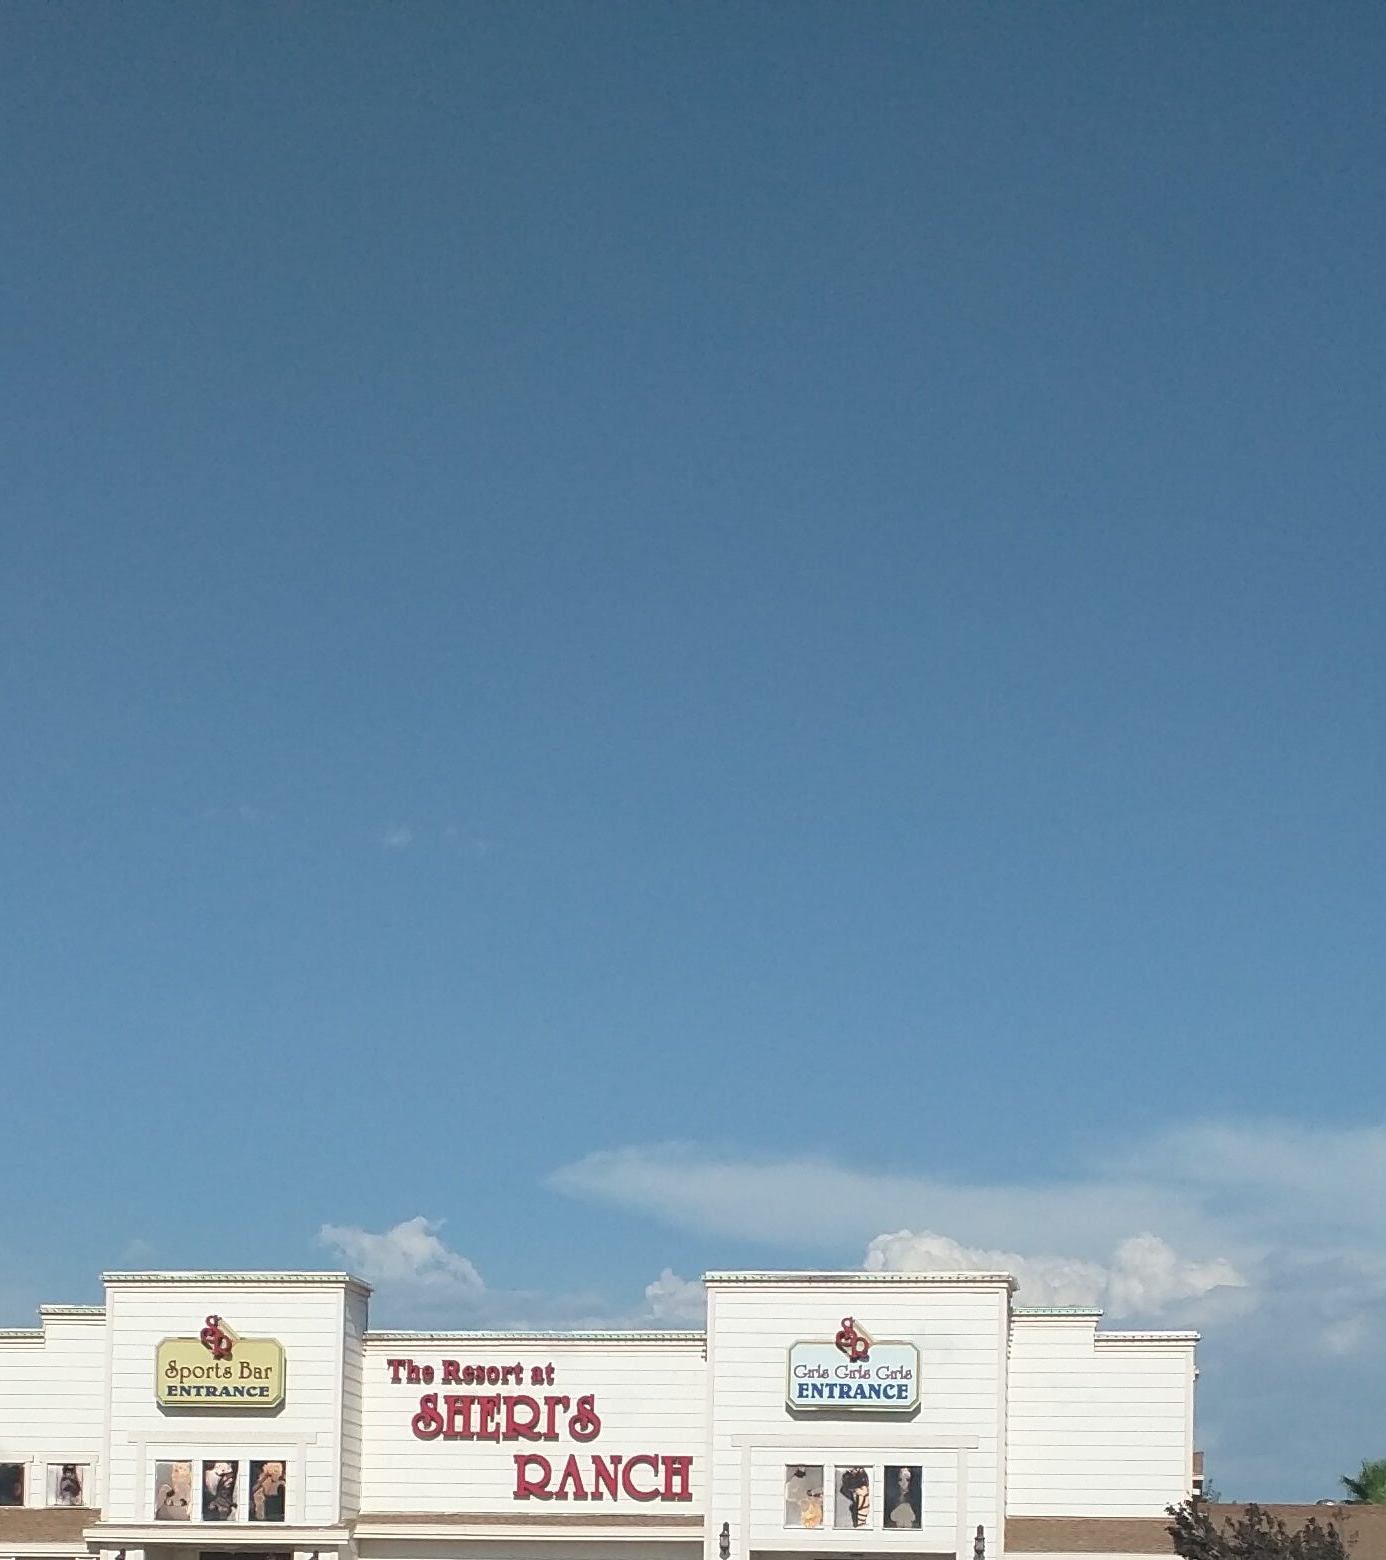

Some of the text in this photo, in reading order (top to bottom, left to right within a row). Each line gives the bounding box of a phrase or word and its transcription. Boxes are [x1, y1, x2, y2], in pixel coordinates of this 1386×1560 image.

[165, 1360, 273, 1384] Sports Bar
[387, 1358, 556, 1386] The Resort at
[793, 1363, 913, 1380] Girls Girls Girls
[166, 1385, 270, 1398] ENTRANCE
[797, 1382, 909, 1400] ENTRANCE
[411, 1393, 602, 1443] SHERI'S
[512, 1453, 693, 1503] RANCH
